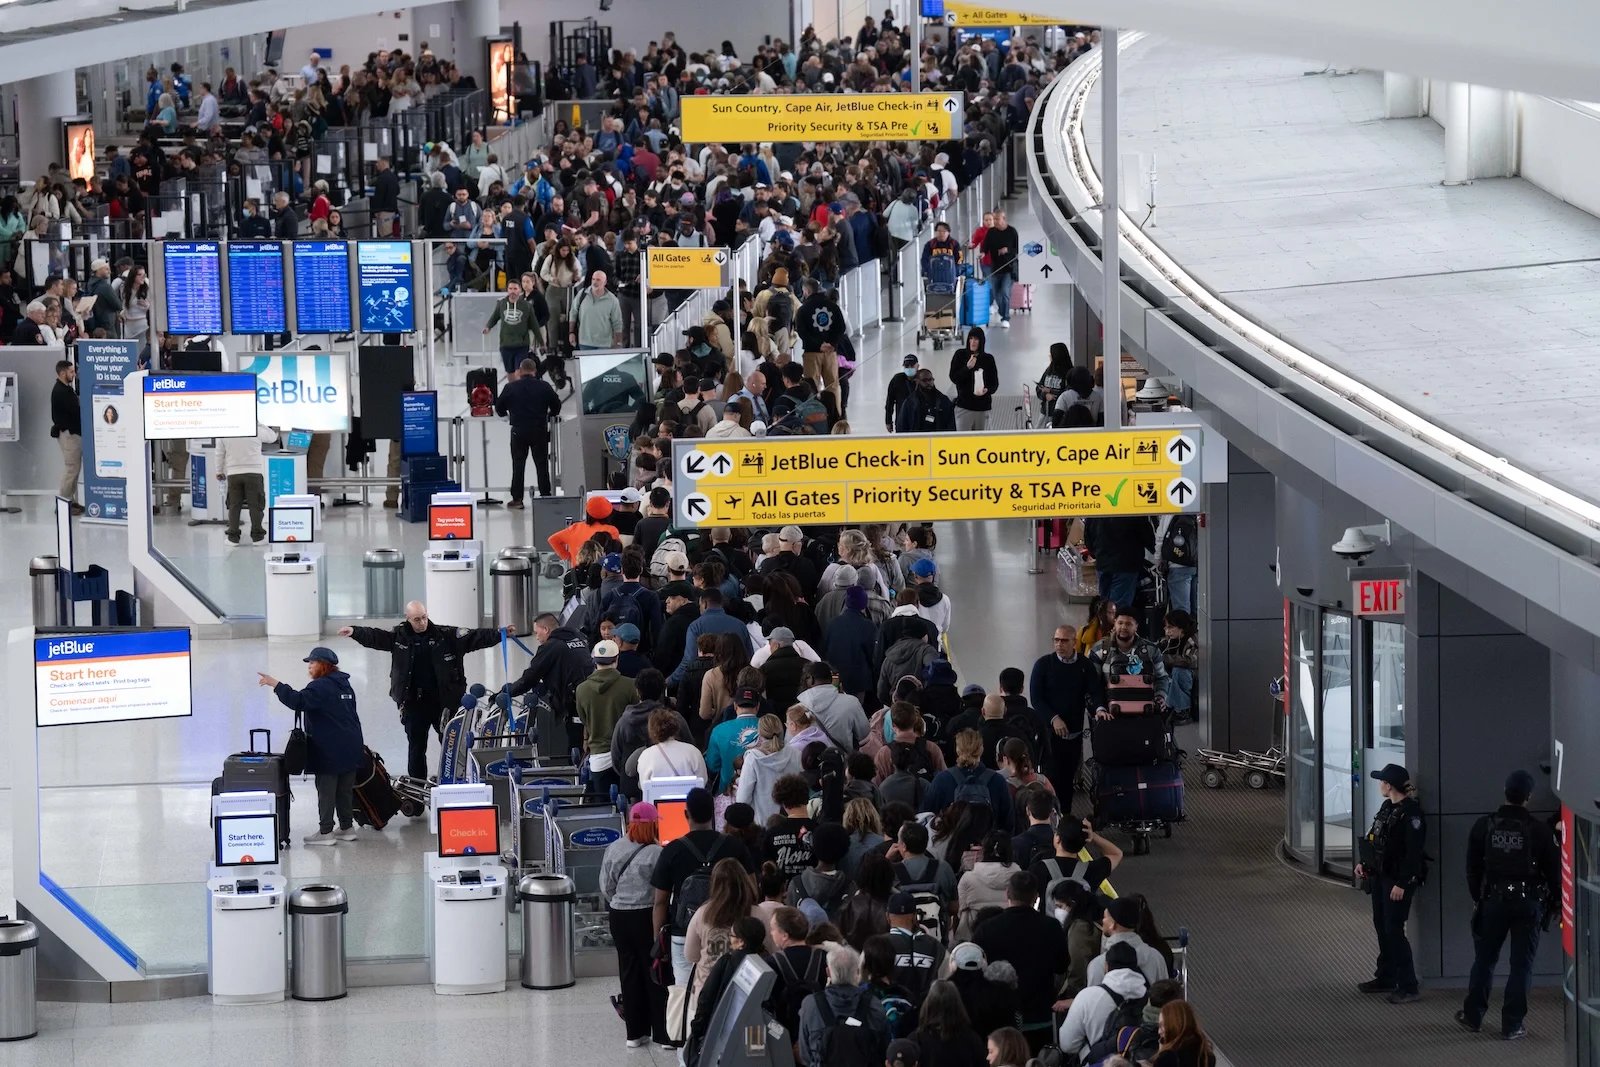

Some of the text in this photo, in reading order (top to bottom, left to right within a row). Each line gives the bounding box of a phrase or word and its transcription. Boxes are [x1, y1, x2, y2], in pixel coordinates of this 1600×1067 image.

[712, 101, 922, 114] Sun Country, Cape Air, JetBlue Check-in
[768, 121, 908, 133] Priority Security & TSA Pre
[196, 244, 215, 252] jetBlue
[666, 254, 690, 262] Gates
[88, 345, 121, 354] Everything
[152, 379, 186, 391] jetBlue
[257, 380, 337, 404] etBlue
[154, 399, 178, 408] Start
[607, 429, 630, 437] POLIC
[771, 450, 924, 471] JetBlue Check-in
[938, 444, 1130, 467] Sun Country, Cape Air
[752, 490, 840, 507] All Gates
[853, 481, 1101, 506] Priority Security & TSA Pre
[1012, 502, 1101, 513] Seguridad Prioritaria
[752, 512, 776, 520] Todas
[793, 510, 826, 520] puertas
[1276, 546, 1281, 586] 6
[1360, 581, 1399, 612] EXIT
[48, 640, 94, 658] jetBlue
[50, 668, 116, 681] Start here
[50, 697, 95, 707] Comenzar
[445, 729, 456, 779] smartecarte
[1554, 739, 1564, 791] 7
[450, 829, 477, 837] Check
[1492, 835, 1524, 845] POLICE
